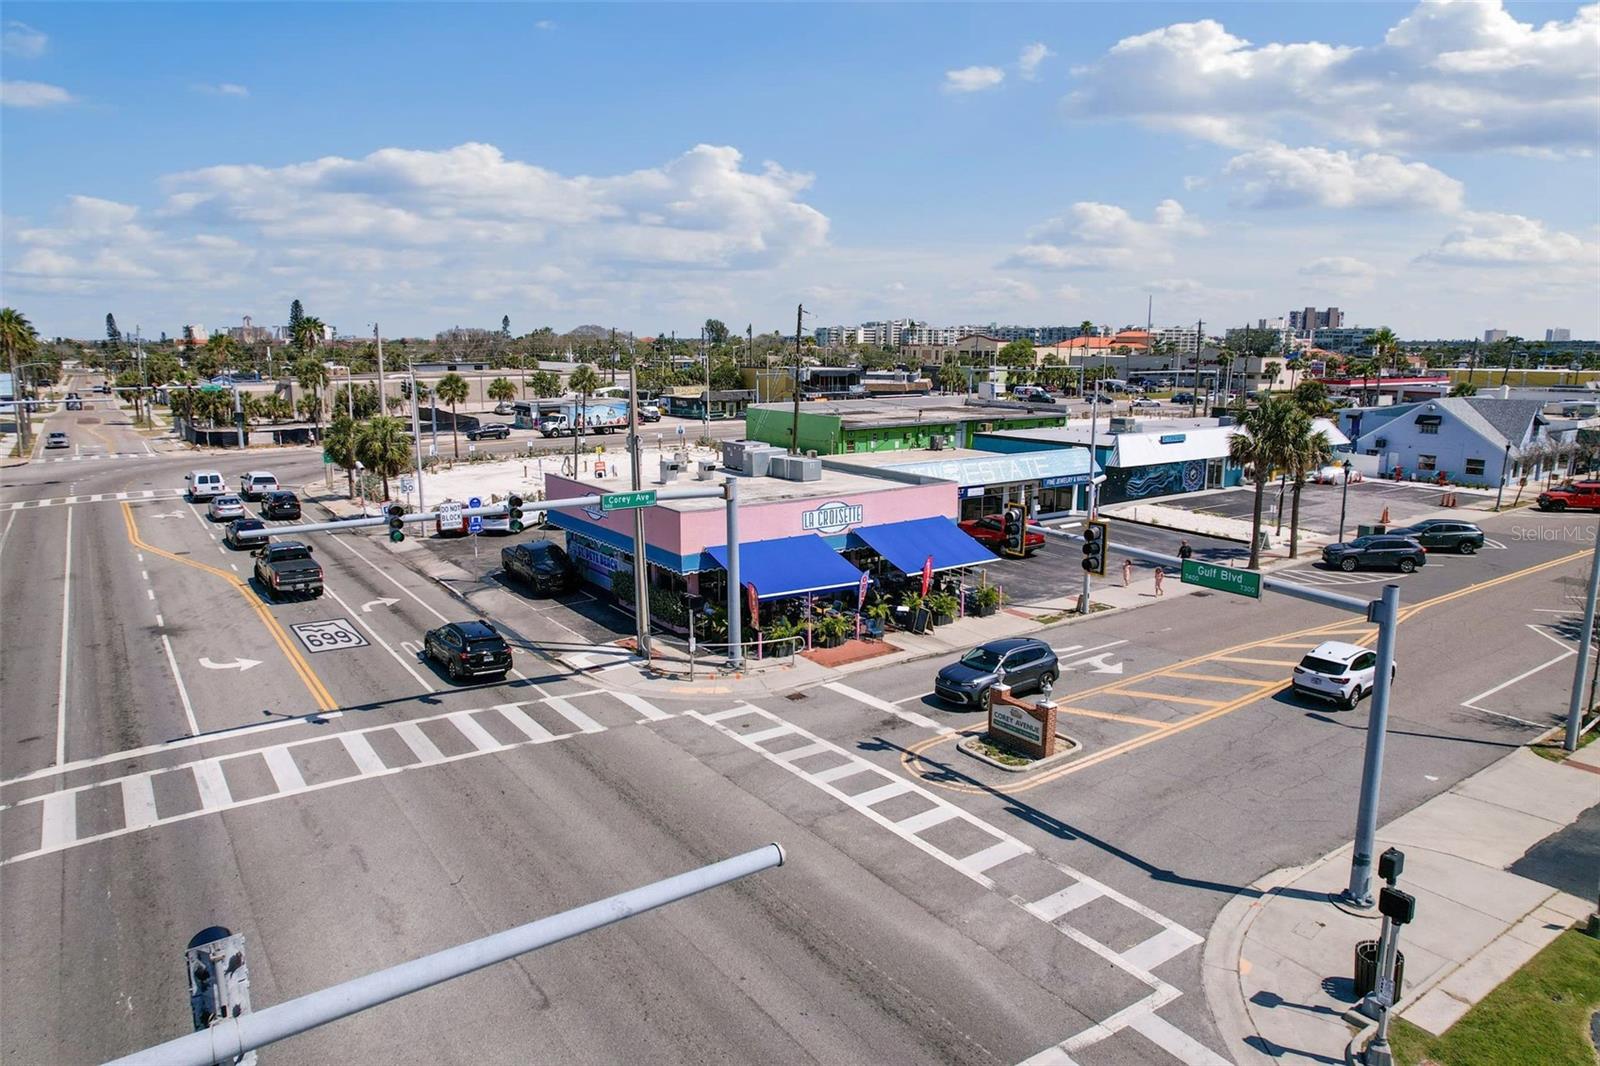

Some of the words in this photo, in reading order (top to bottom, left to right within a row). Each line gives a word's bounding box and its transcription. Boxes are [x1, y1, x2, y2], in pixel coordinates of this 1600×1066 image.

[963, 456, 1049, 484] ESTATE
[608, 496, 631, 504] Corey
[804, 512, 814, 528] LA
[817, 506, 861, 526] CROISETTE
[1197, 565, 1217, 578] Gulf
[1220, 570, 1243, 583] Blvd
[306, 630, 353, 647] 699
[993, 711, 1014, 724] COREY
[1015, 719, 1040, 734] AVENUE
